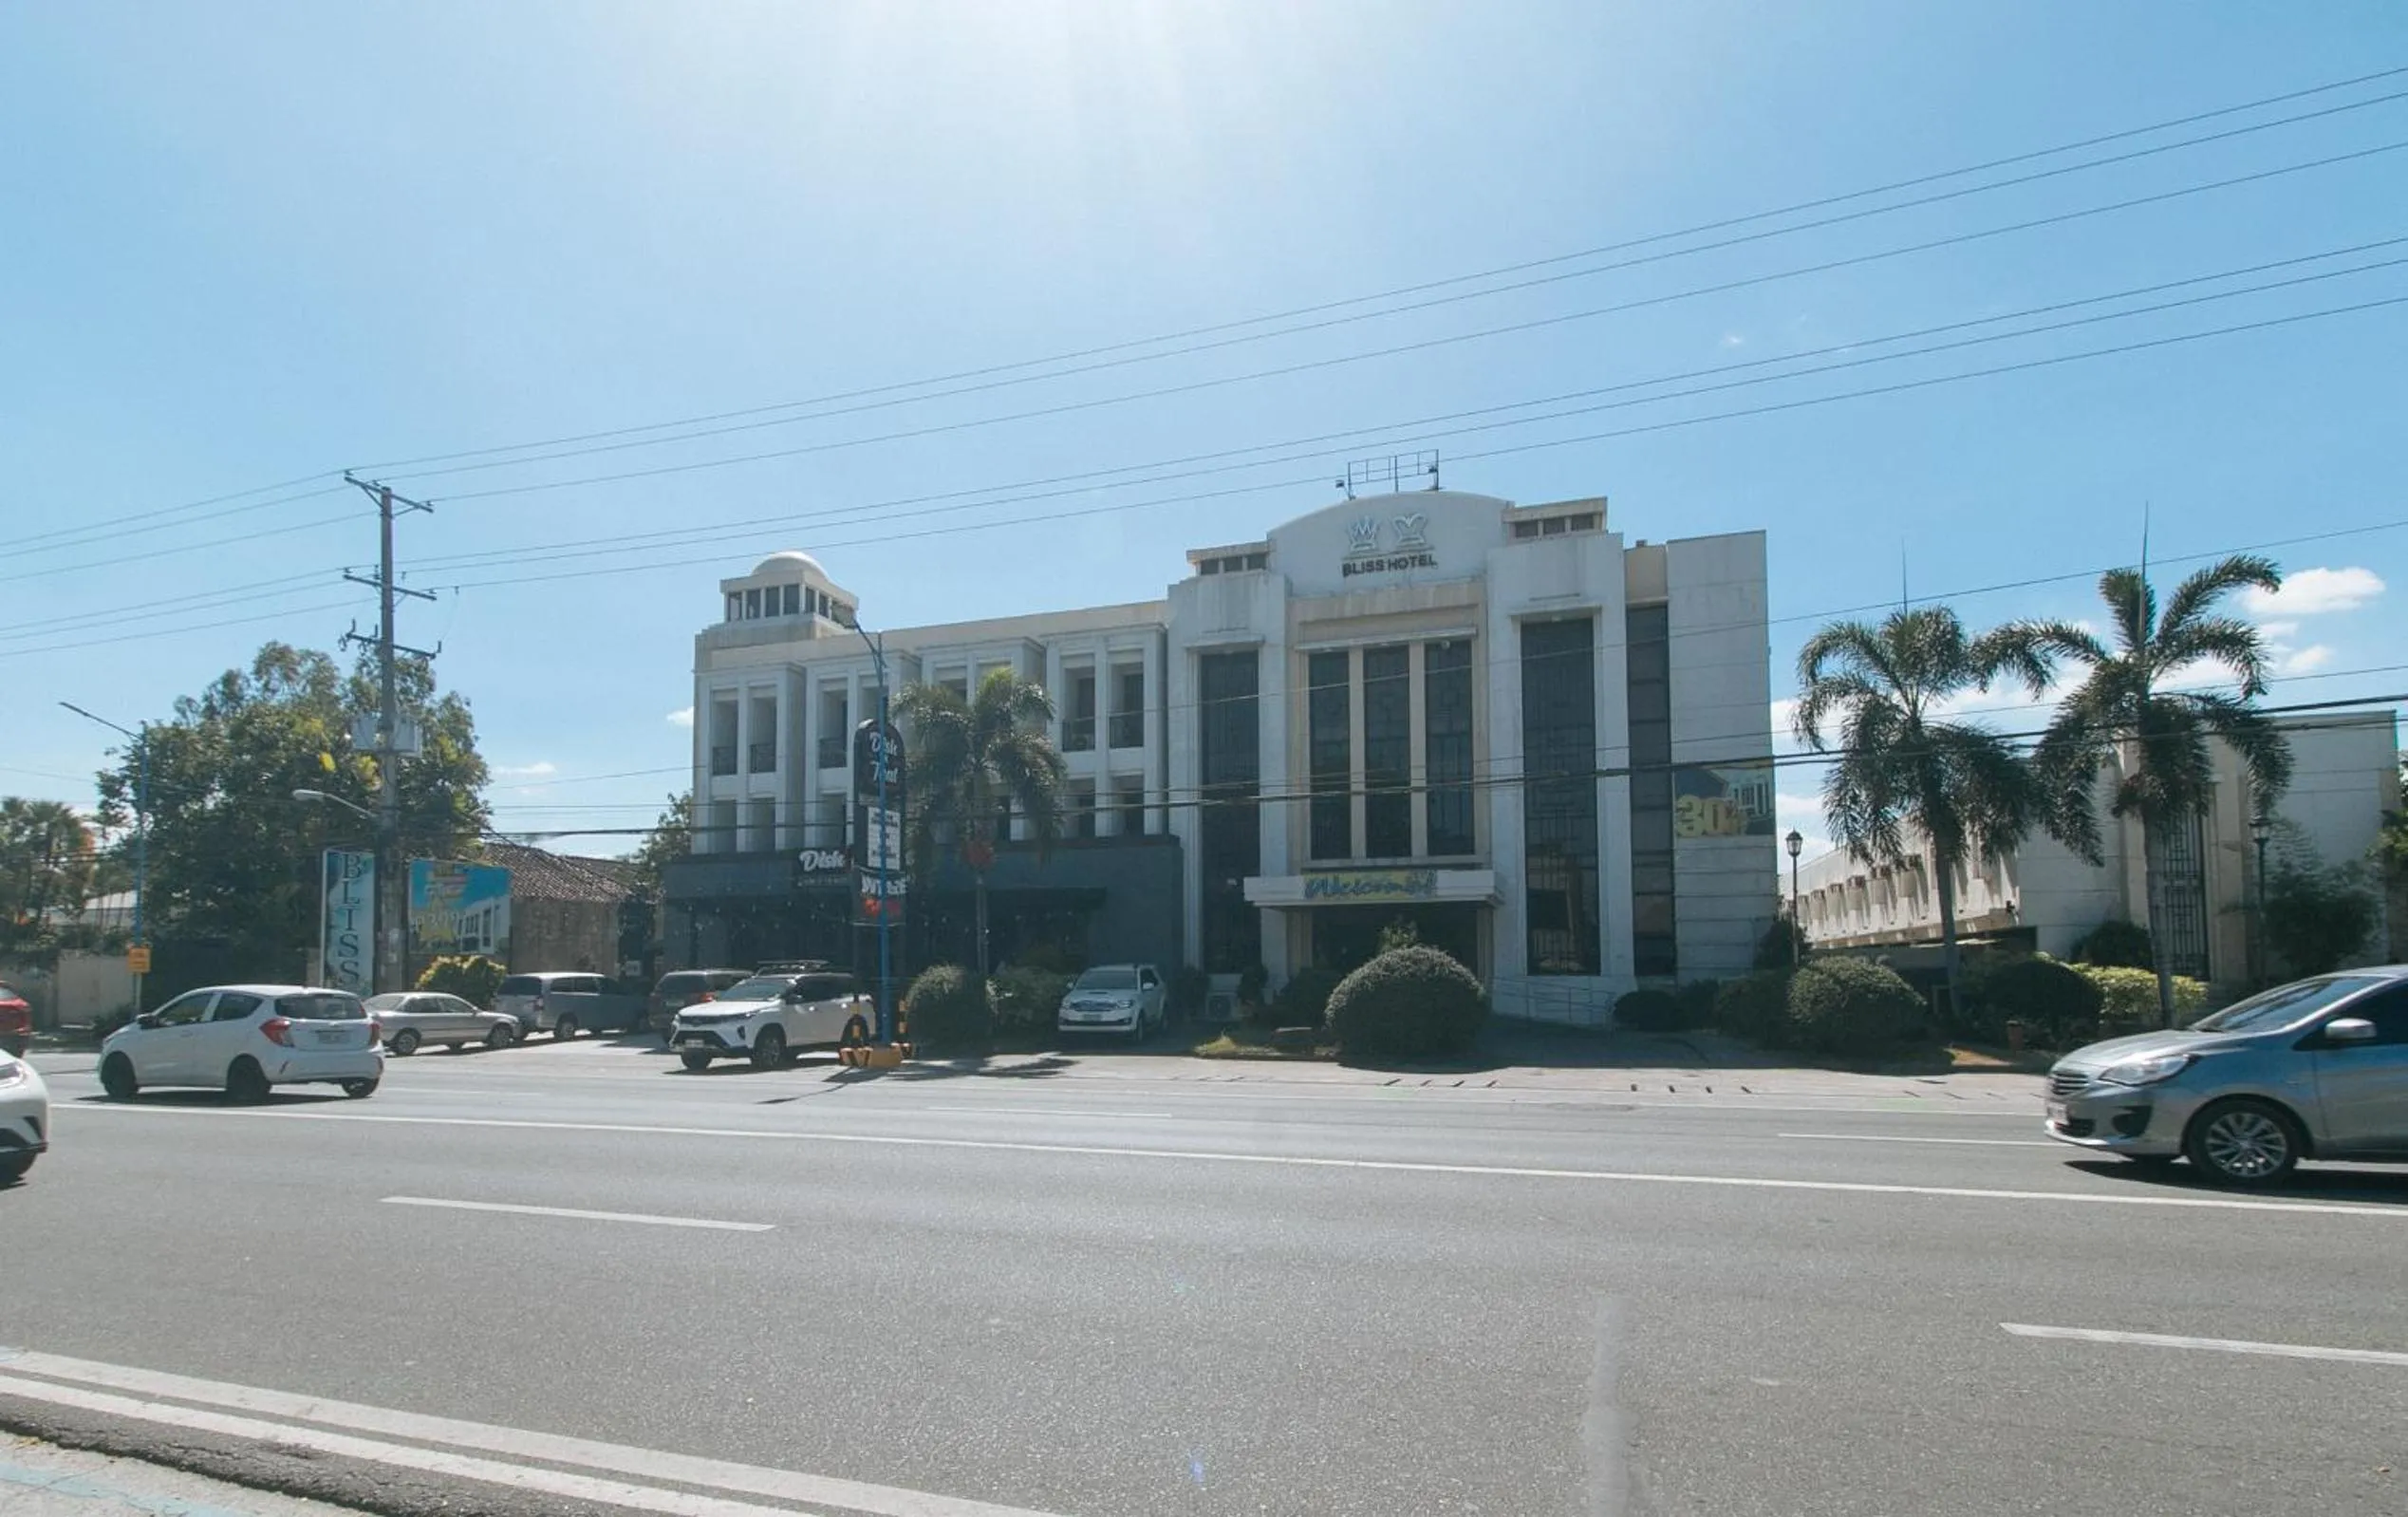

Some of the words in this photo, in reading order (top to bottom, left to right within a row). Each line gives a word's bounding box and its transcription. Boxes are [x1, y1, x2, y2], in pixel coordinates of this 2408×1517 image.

[1342, 558, 1385, 577] BLISS
[1388, 553, 1435, 571] HOTEL
[338, 853, 362, 985] BLISS
